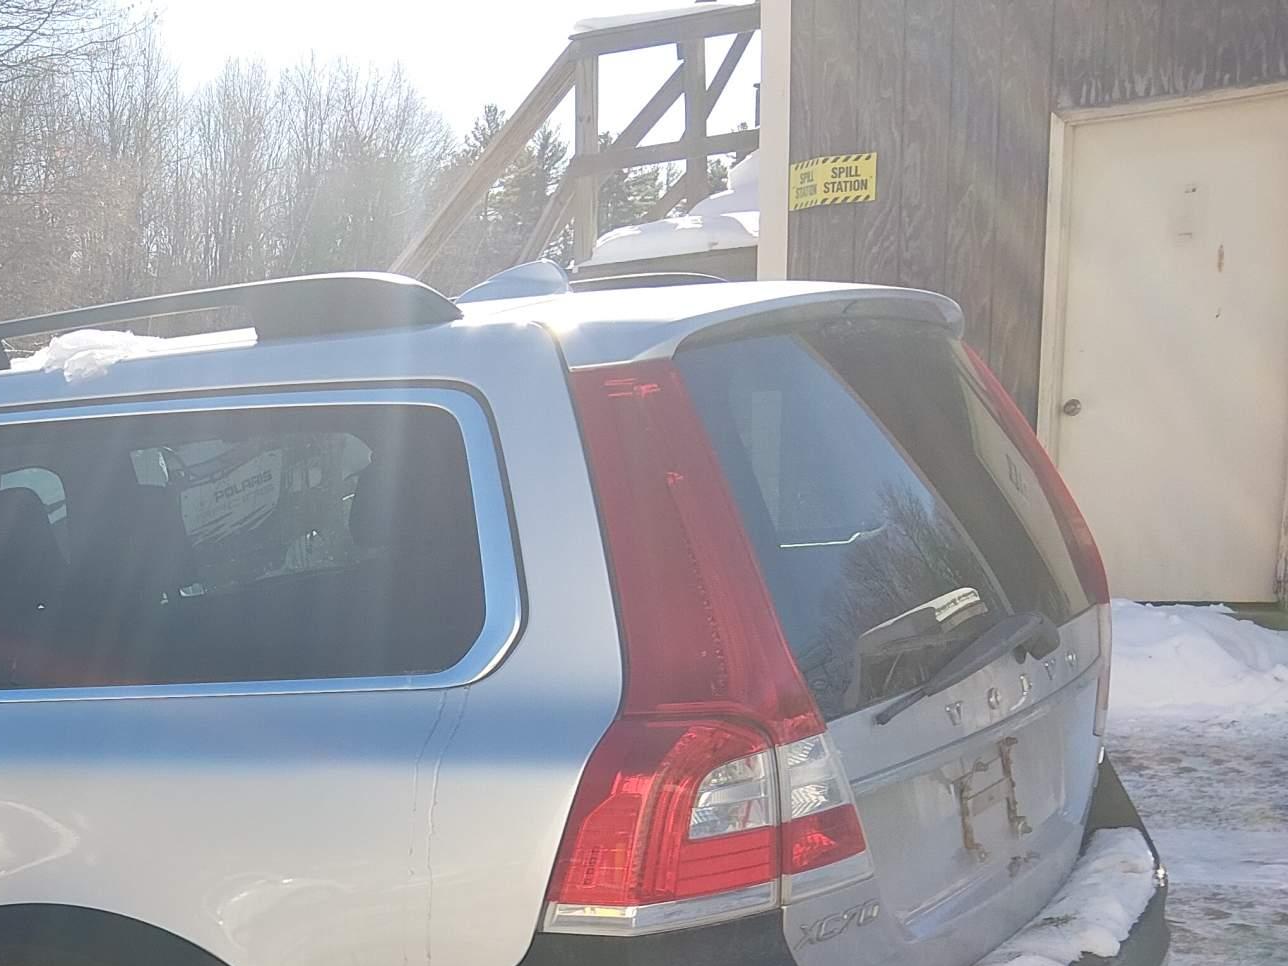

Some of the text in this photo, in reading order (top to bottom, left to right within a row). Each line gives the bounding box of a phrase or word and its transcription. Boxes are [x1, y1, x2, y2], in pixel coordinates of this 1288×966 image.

[823, 178, 868, 194] STATION
[831, 165, 861, 179] SPILL
[214, 470, 273, 503] POLARIS
[945, 650, 1078, 726] VOLVO
[793, 898, 880, 952] XC70
